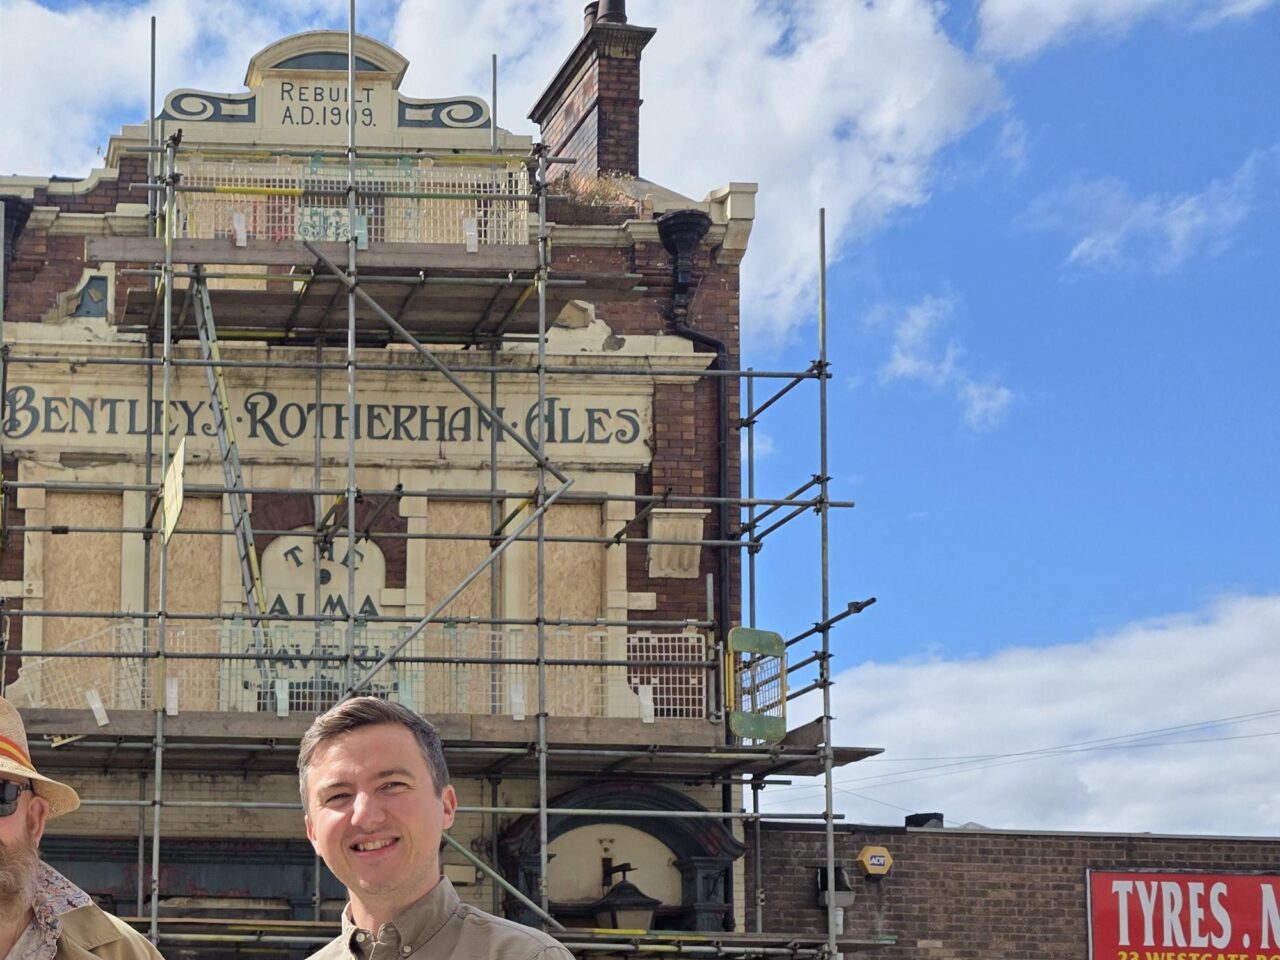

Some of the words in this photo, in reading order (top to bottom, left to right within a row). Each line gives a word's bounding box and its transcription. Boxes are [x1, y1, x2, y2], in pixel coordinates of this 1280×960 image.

[243, 391, 506, 447] ROTHERHAM
[525, 397, 641, 450] ALES
[870, 856, 886, 866] ADT
